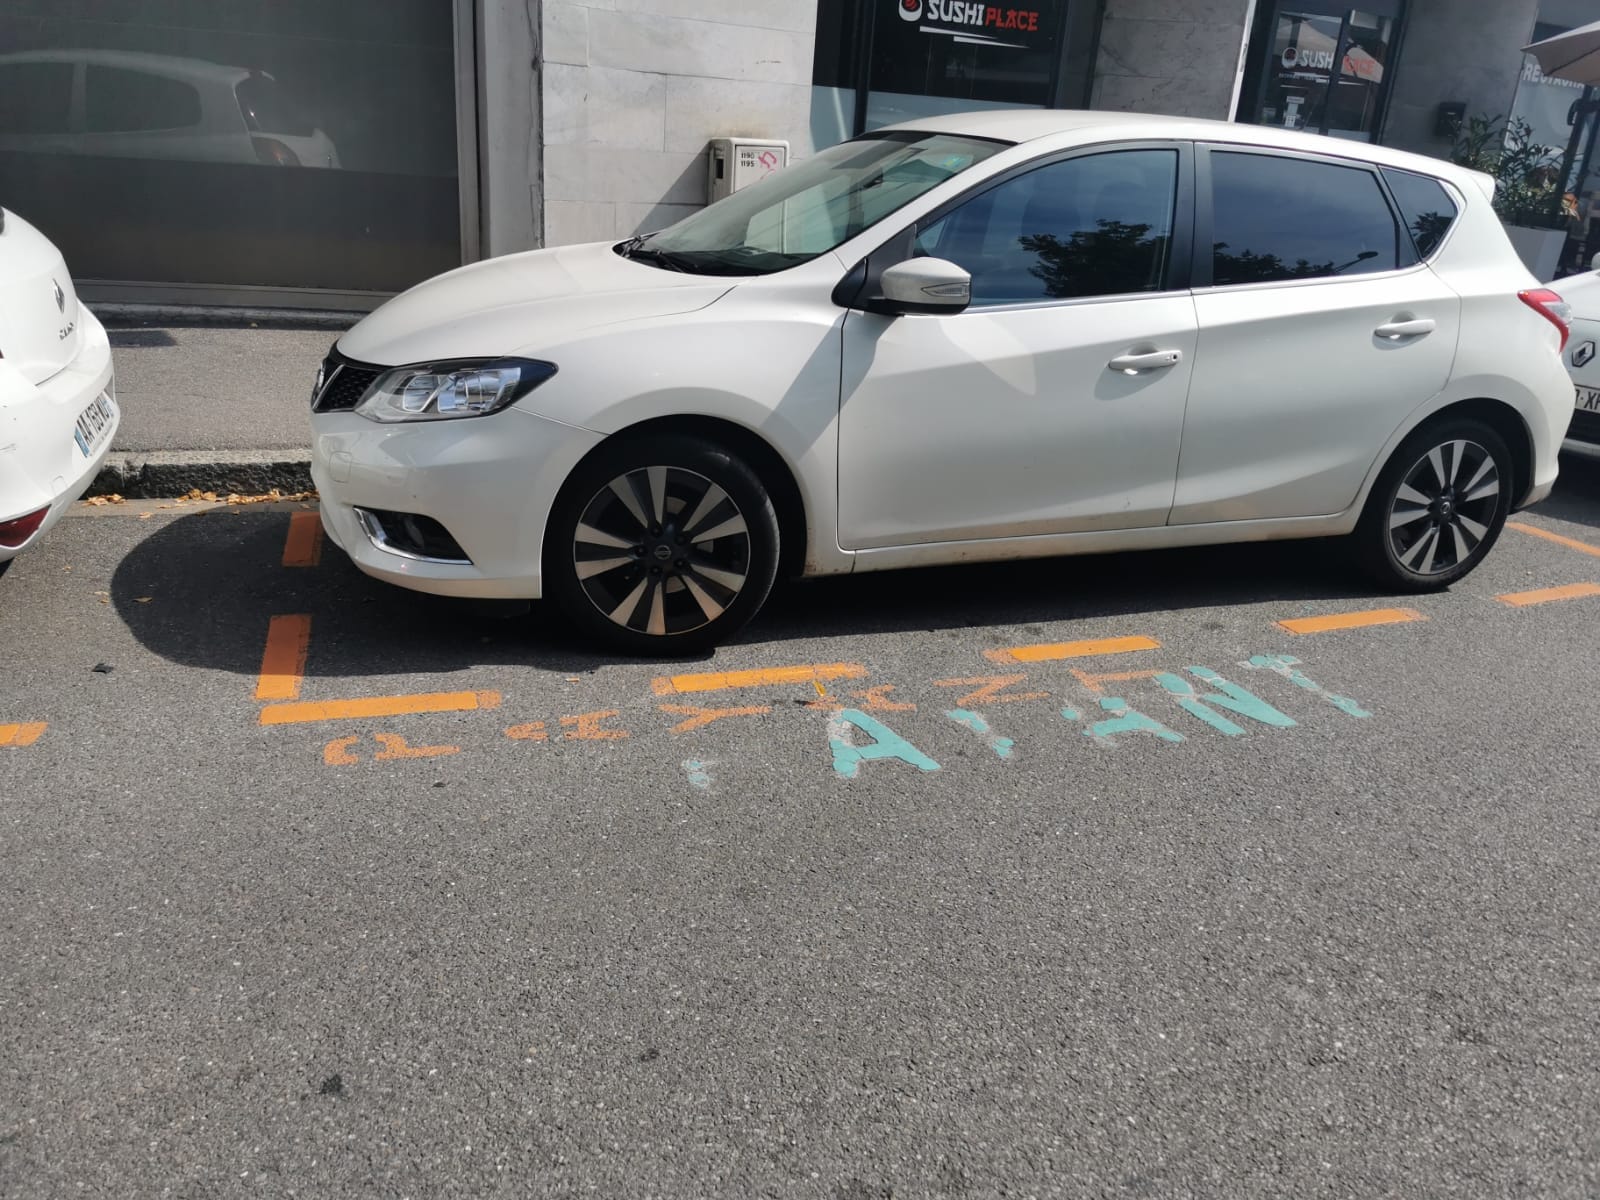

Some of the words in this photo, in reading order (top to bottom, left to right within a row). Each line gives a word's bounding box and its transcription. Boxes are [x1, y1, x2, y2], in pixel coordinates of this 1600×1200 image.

[927, 0, 985, 26] SUSHI
[985, 7, 1040, 32] PLACE
[1300, 49, 1334, 70] SUSH
